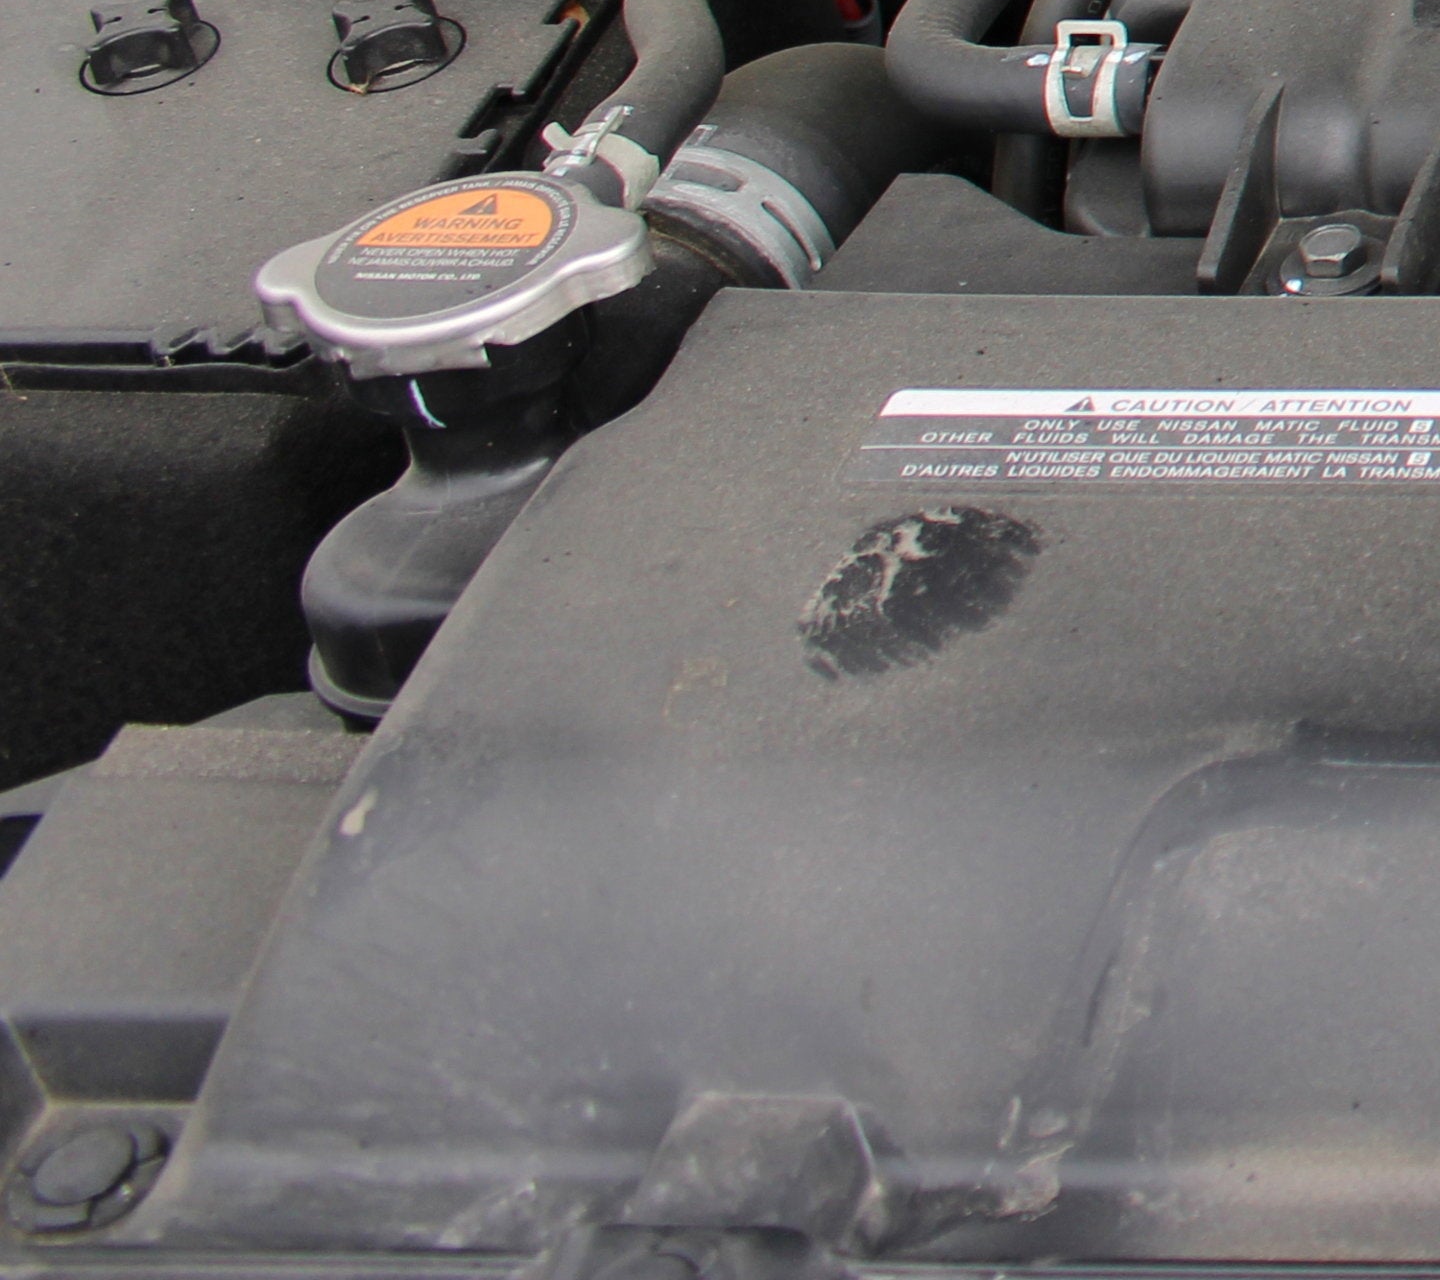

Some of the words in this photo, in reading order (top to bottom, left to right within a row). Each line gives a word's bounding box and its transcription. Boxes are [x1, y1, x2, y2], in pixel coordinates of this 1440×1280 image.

[460, 180, 492, 190] TANK
[412, 217, 523, 231] WARNING
[369, 232, 541, 245] AVERTISSEMENT
[360, 247, 406, 256] NEVER
[406, 248, 446, 257] OPEN
[447, 248, 491, 257] WHEN
[347, 256, 369, 265] NE
[364, 257, 412, 266] JAMAIS
[411, 258, 460, 267] OUVRIR
[354, 272, 398, 280] NISSAN
[1111, 399, 1235, 413] CAUTION
[1260, 399, 1413, 413] ATTENTION
[1023, 419, 1081, 431] ONLY
[1096, 419, 1141, 431] USE
[1156, 420, 1238, 431] NISSAN
[1253, 420, 1320, 432] MATIC
[1336, 420, 1399, 432] FLUID
[920, 432, 994, 443] OTHER
[1011, 433, 1089, 444] FLUIDS
[1110, 433, 1160, 444] WILL
[1182, 433, 1275, 445] DAMAGE
[1297, 433, 1339, 445] THE
[1004, 451, 1106, 464] N'UTILISER
[1108, 452, 1151, 464] QUE
[1153, 452, 1184, 464] DU
[1184, 452, 1262, 464] LIQUIDE
[1262, 452, 1324, 464] MATIC
[1324, 452, 1399, 465] NISSAN
[900, 464, 999, 477] D'AUTRES
[1007, 465, 1102, 478] LIQUIDES
[1110, 465, 1314, 478] ENDOMMAGERAIENT
[1322, 466, 1348, 478] LA
